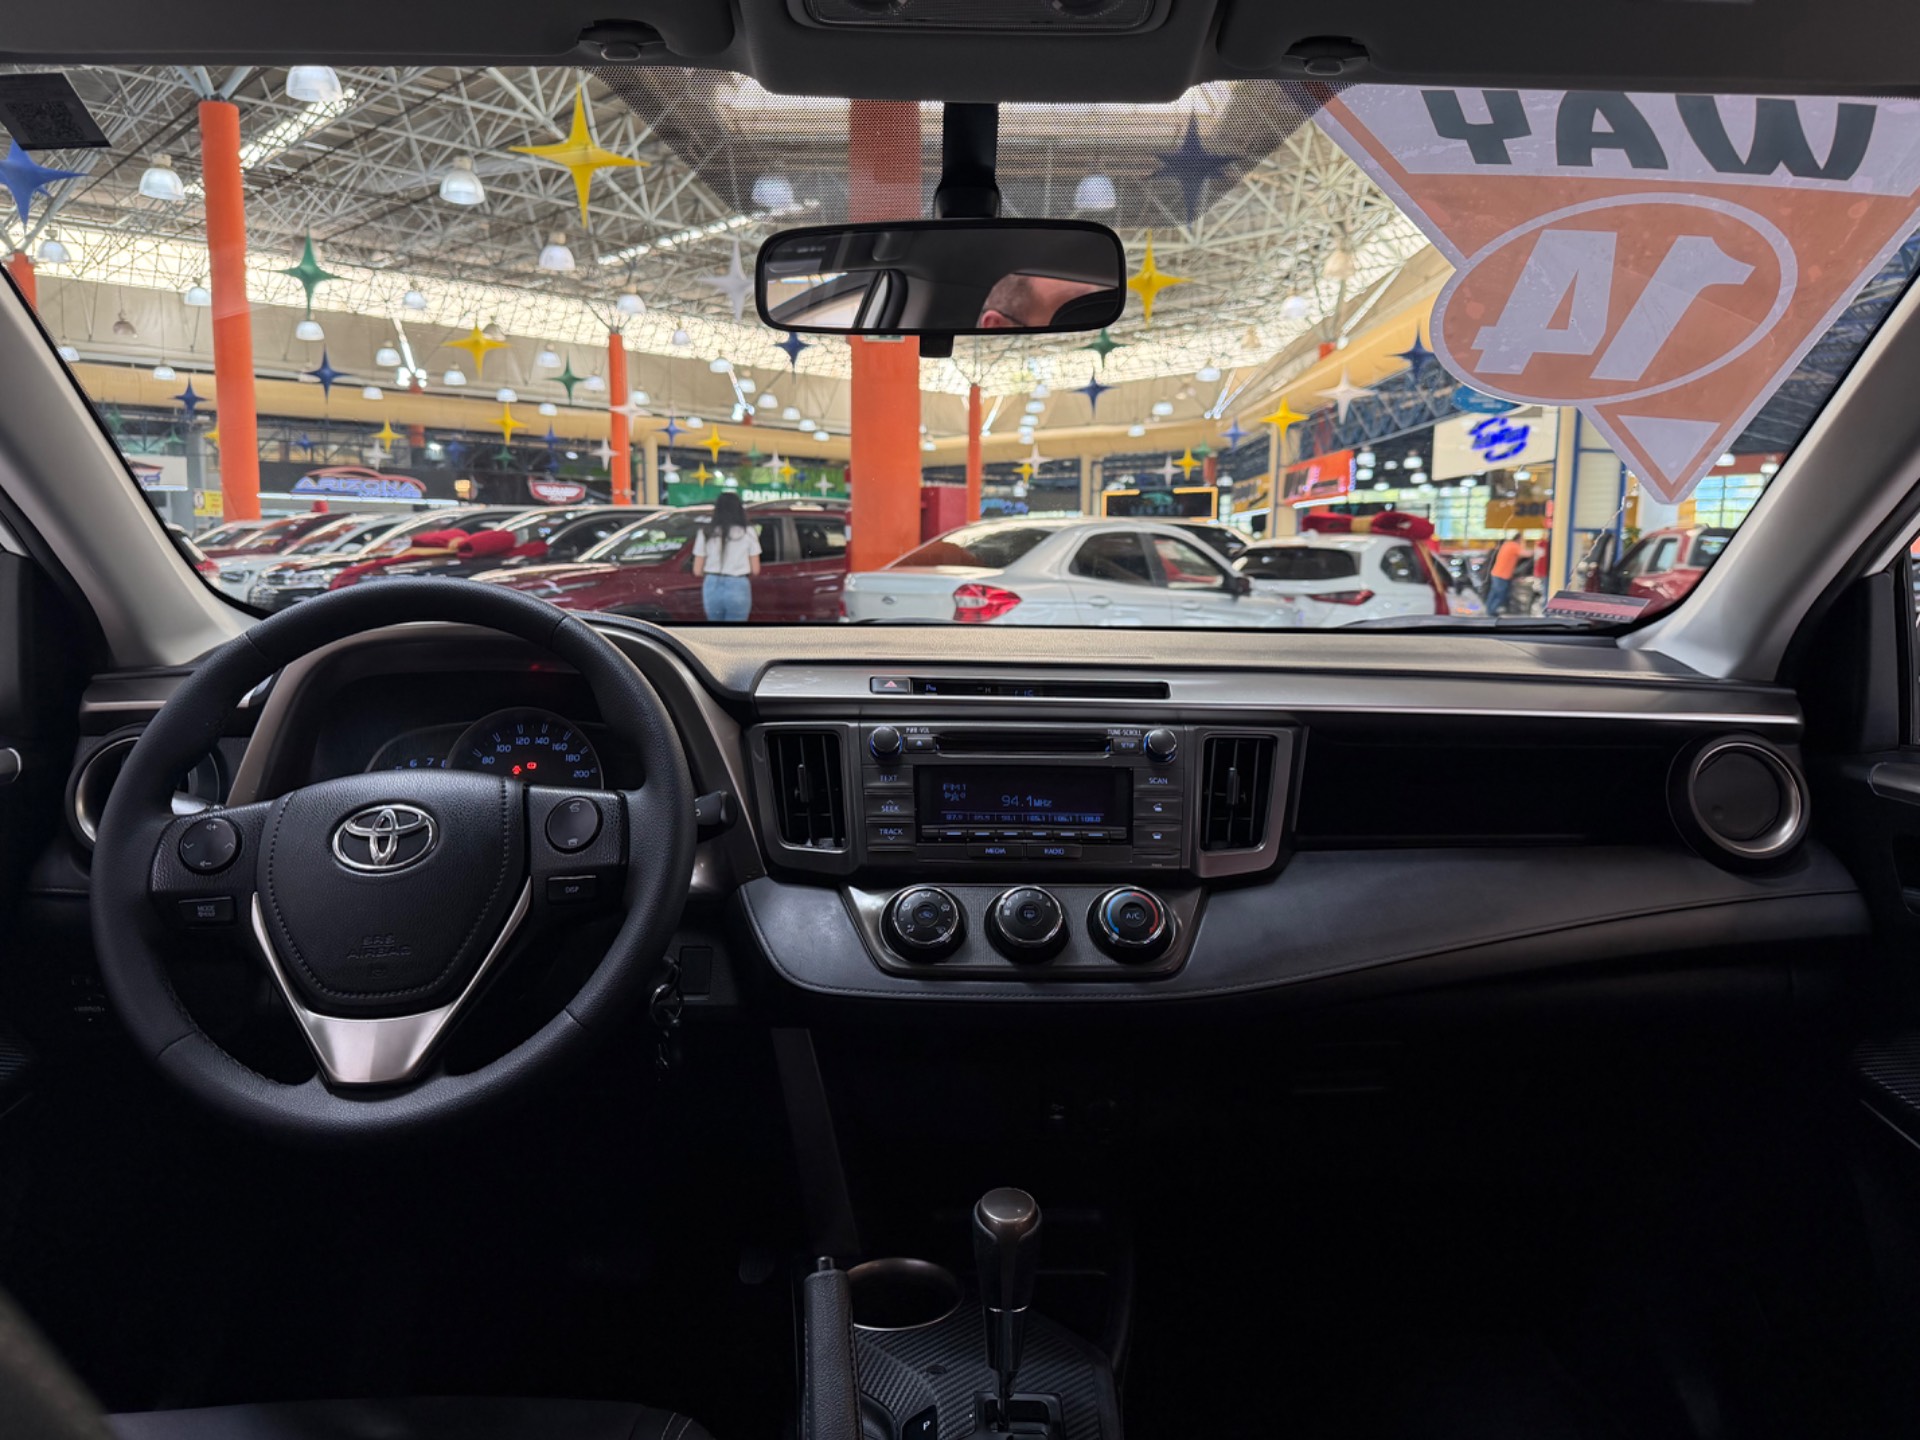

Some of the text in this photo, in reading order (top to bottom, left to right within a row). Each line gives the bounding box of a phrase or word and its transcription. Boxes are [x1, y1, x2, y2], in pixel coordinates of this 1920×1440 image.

[293, 476, 421, 493] ARIZONA
[516, 735, 530, 745] 120
[535, 735, 550, 745] 140
[496, 744, 512, 754] 100
[552, 741, 568, 752] 160
[481, 754, 496, 765] 80
[566, 752, 581, 763] 180
[573, 769, 590, 779] 200
[1149, 777, 1168, 785] SCAN
[881, 805, 900, 813] SEEK
[880, 828, 903, 836] TRACK
[985, 846, 1007, 855] MEDIA
[1044, 847, 1065, 856] RADIO
[1126, 911, 1141, 920] A/C
[345, 945, 412, 959] AIRBAG
